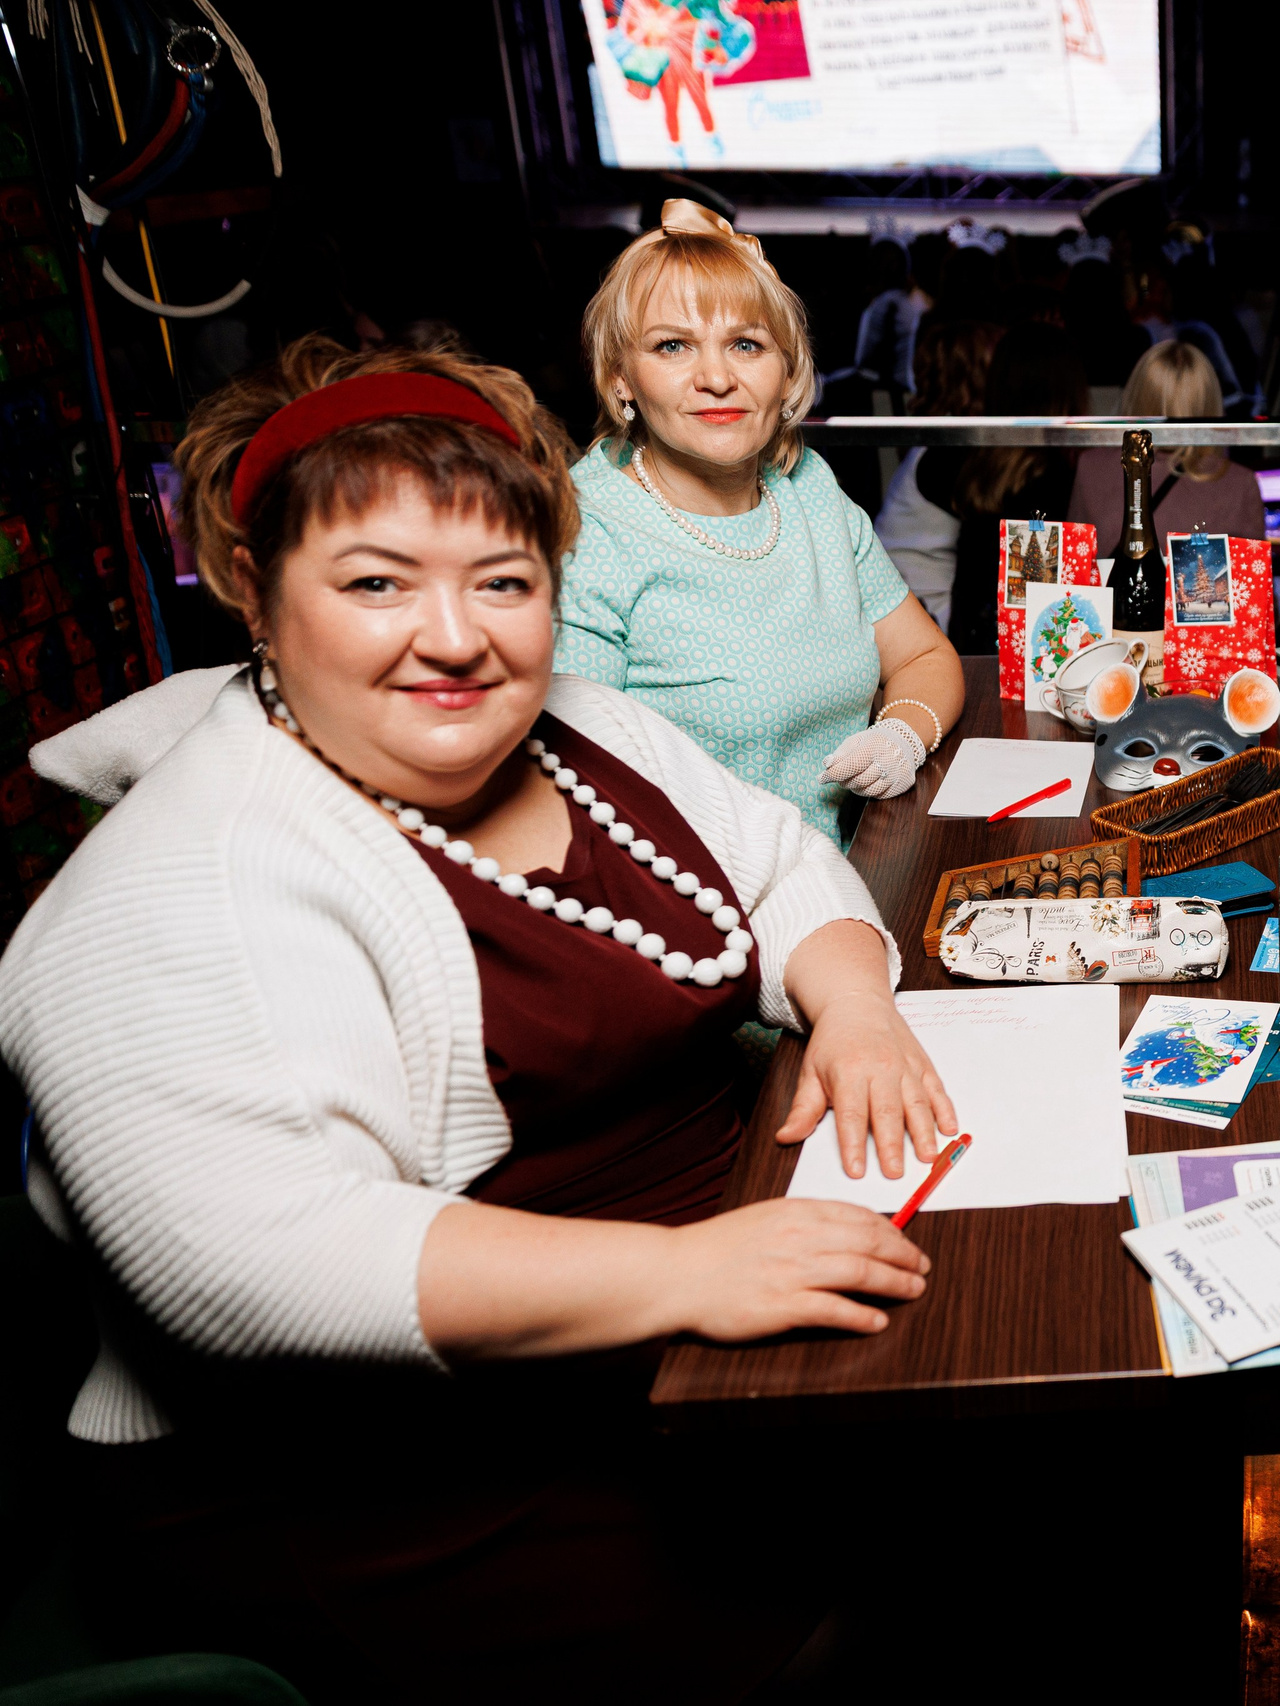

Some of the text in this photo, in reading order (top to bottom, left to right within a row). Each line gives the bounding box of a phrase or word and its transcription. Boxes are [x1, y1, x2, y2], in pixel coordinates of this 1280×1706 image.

[1039, 907, 1066, 919] make
[1059, 918, 1084, 932] Love
[1156, 1246, 1220, 1299] рулем
[1196, 1294, 1240, 1323] За
